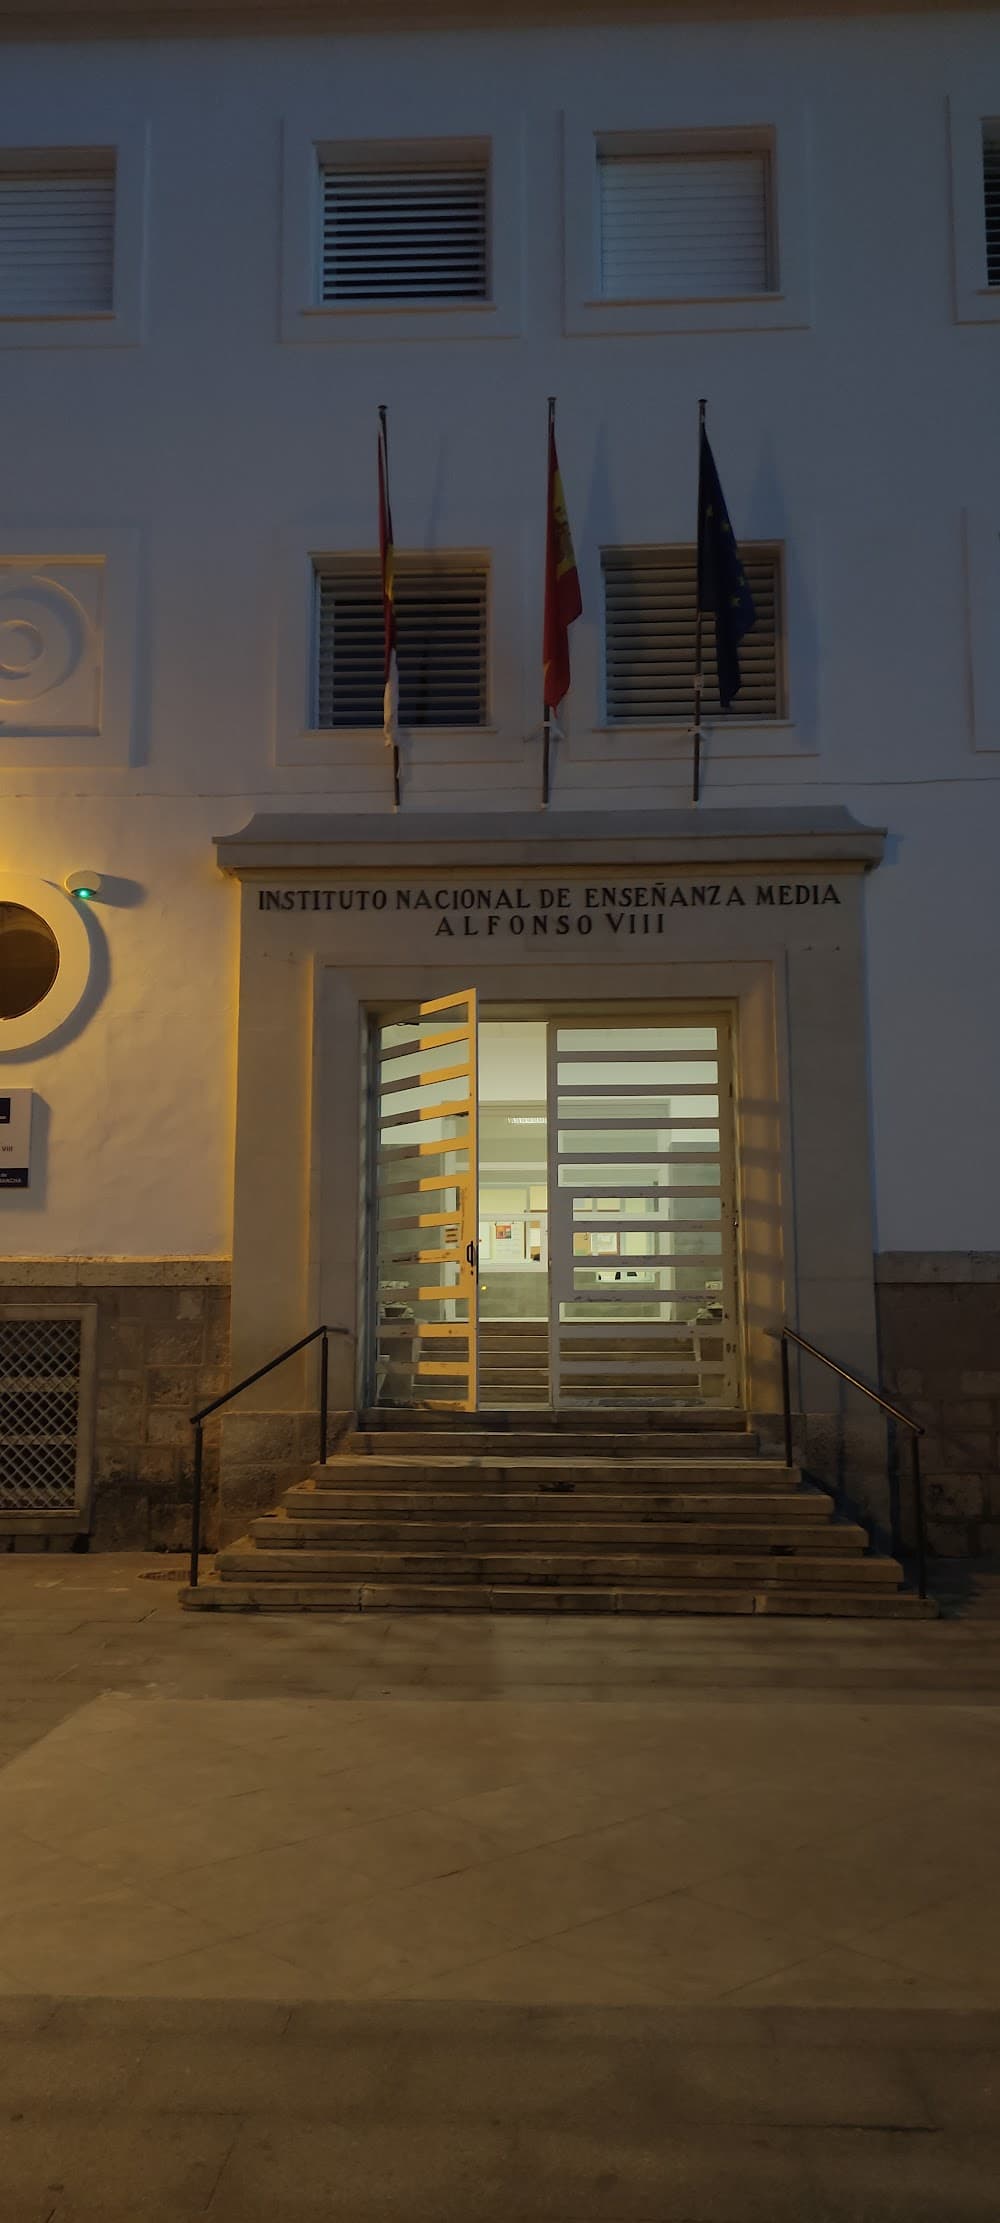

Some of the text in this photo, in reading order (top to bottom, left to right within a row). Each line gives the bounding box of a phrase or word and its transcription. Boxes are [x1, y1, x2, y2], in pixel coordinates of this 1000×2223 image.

[259, 882, 841, 910] INSTITUTO NACIONAL DE ENSEÑANZA MEDIA
[435, 913, 664, 936] ALFONSO VIII
